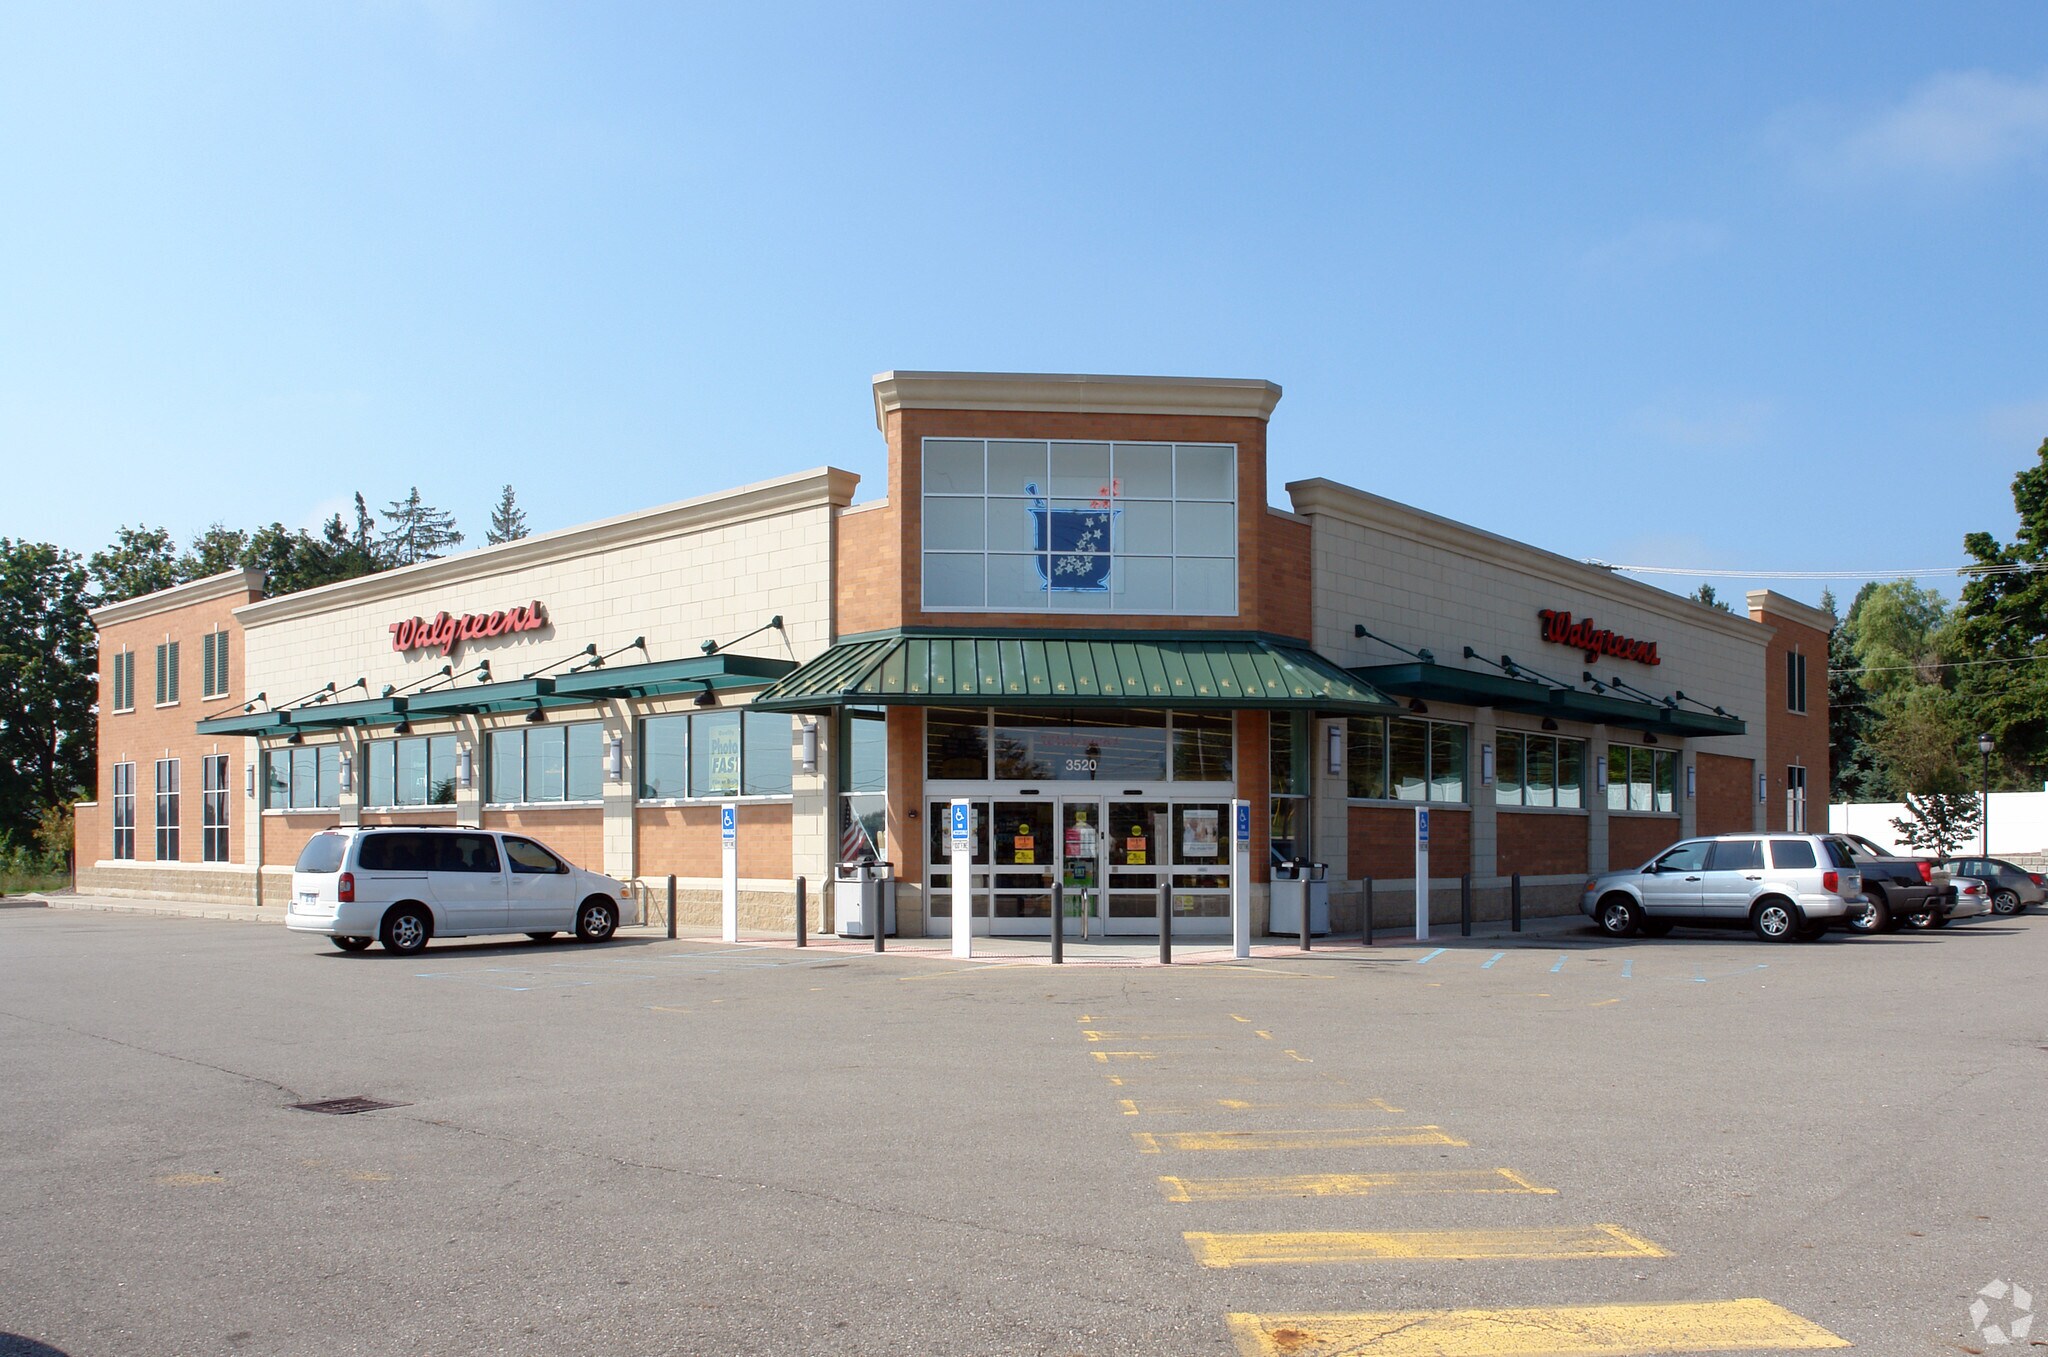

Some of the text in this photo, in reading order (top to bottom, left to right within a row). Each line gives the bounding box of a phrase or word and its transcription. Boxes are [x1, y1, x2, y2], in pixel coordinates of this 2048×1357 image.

[389, 600, 542, 656] Walgreens
[1538, 609, 1661, 665] Walgreens
[711, 738, 738, 755] Photo
[1065, 759, 1097, 771] 3520
